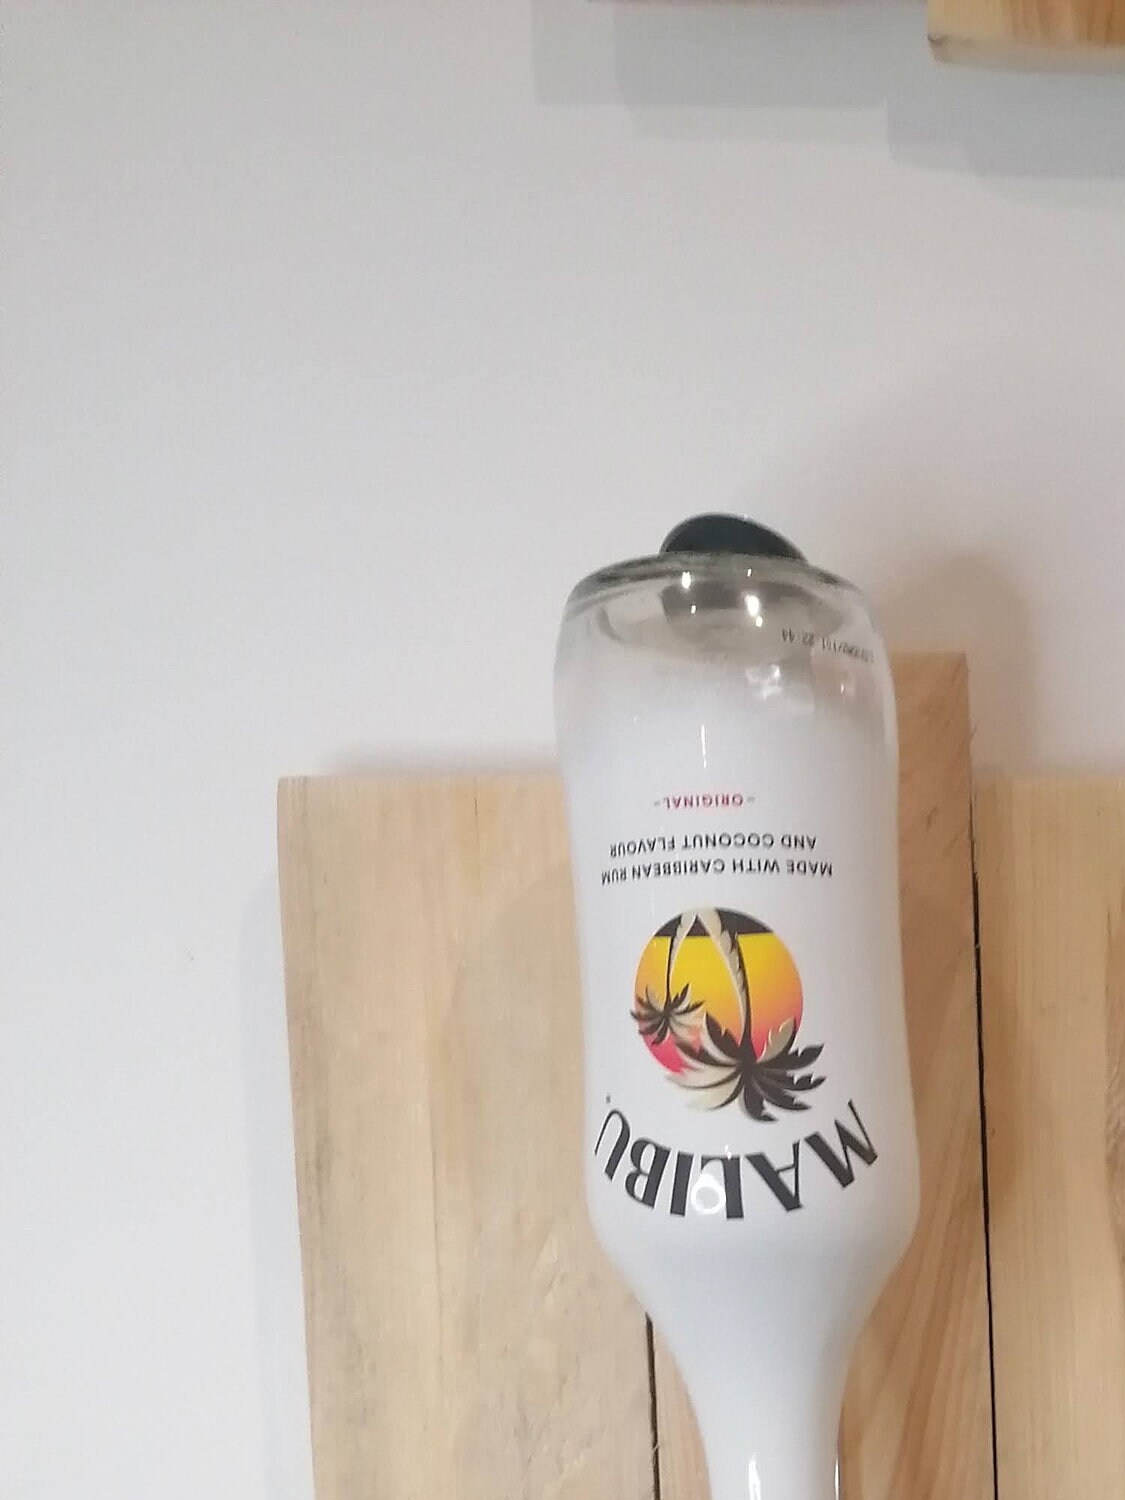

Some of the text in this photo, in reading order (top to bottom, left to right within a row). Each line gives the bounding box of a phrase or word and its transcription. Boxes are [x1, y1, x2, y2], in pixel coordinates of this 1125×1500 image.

[609, 832, 817, 858] AND COCONUT FLAVOUR
[601, 858, 834, 887] MADE WITH CARIBBEAN RUM
[594, 1098, 878, 1219] MALIBU
